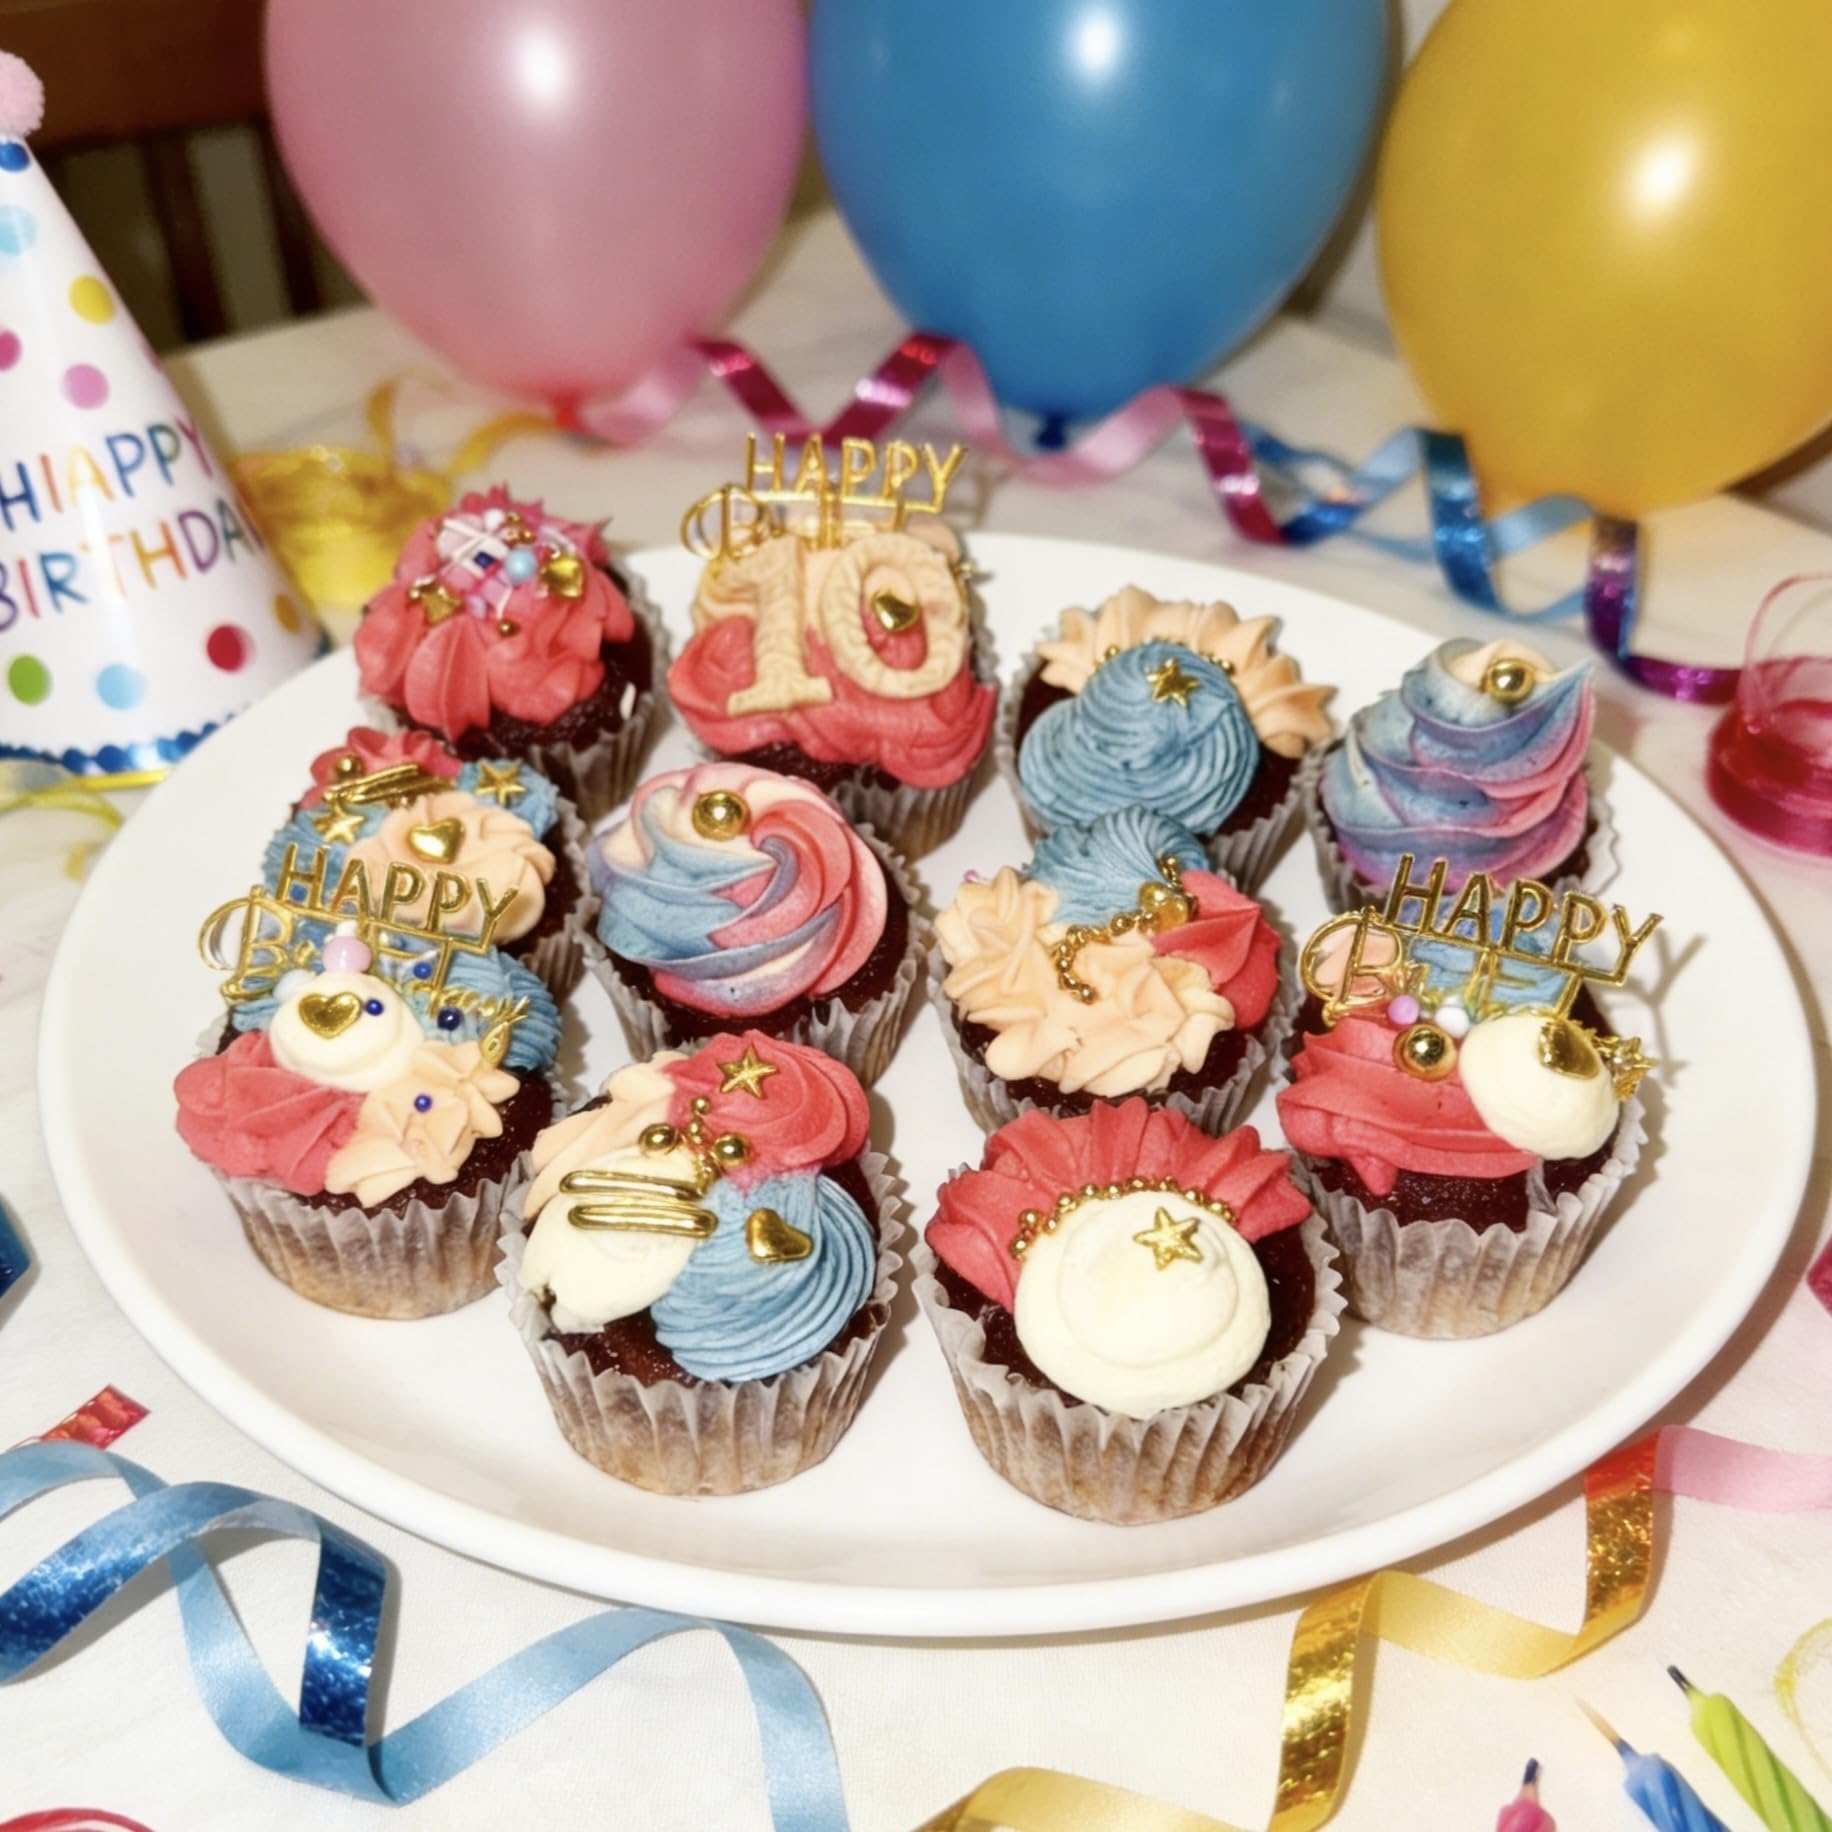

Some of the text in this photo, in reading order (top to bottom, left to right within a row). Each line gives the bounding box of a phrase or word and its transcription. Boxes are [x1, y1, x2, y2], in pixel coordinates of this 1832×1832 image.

[744, 432, 966, 514] HAPPY
[0, 496, 267, 634] BIRTHDA
[701, 533, 968, 716] 10
[275, 842, 521, 956] HAPPY
[1383, 852, 1664, 987] HAPPY
